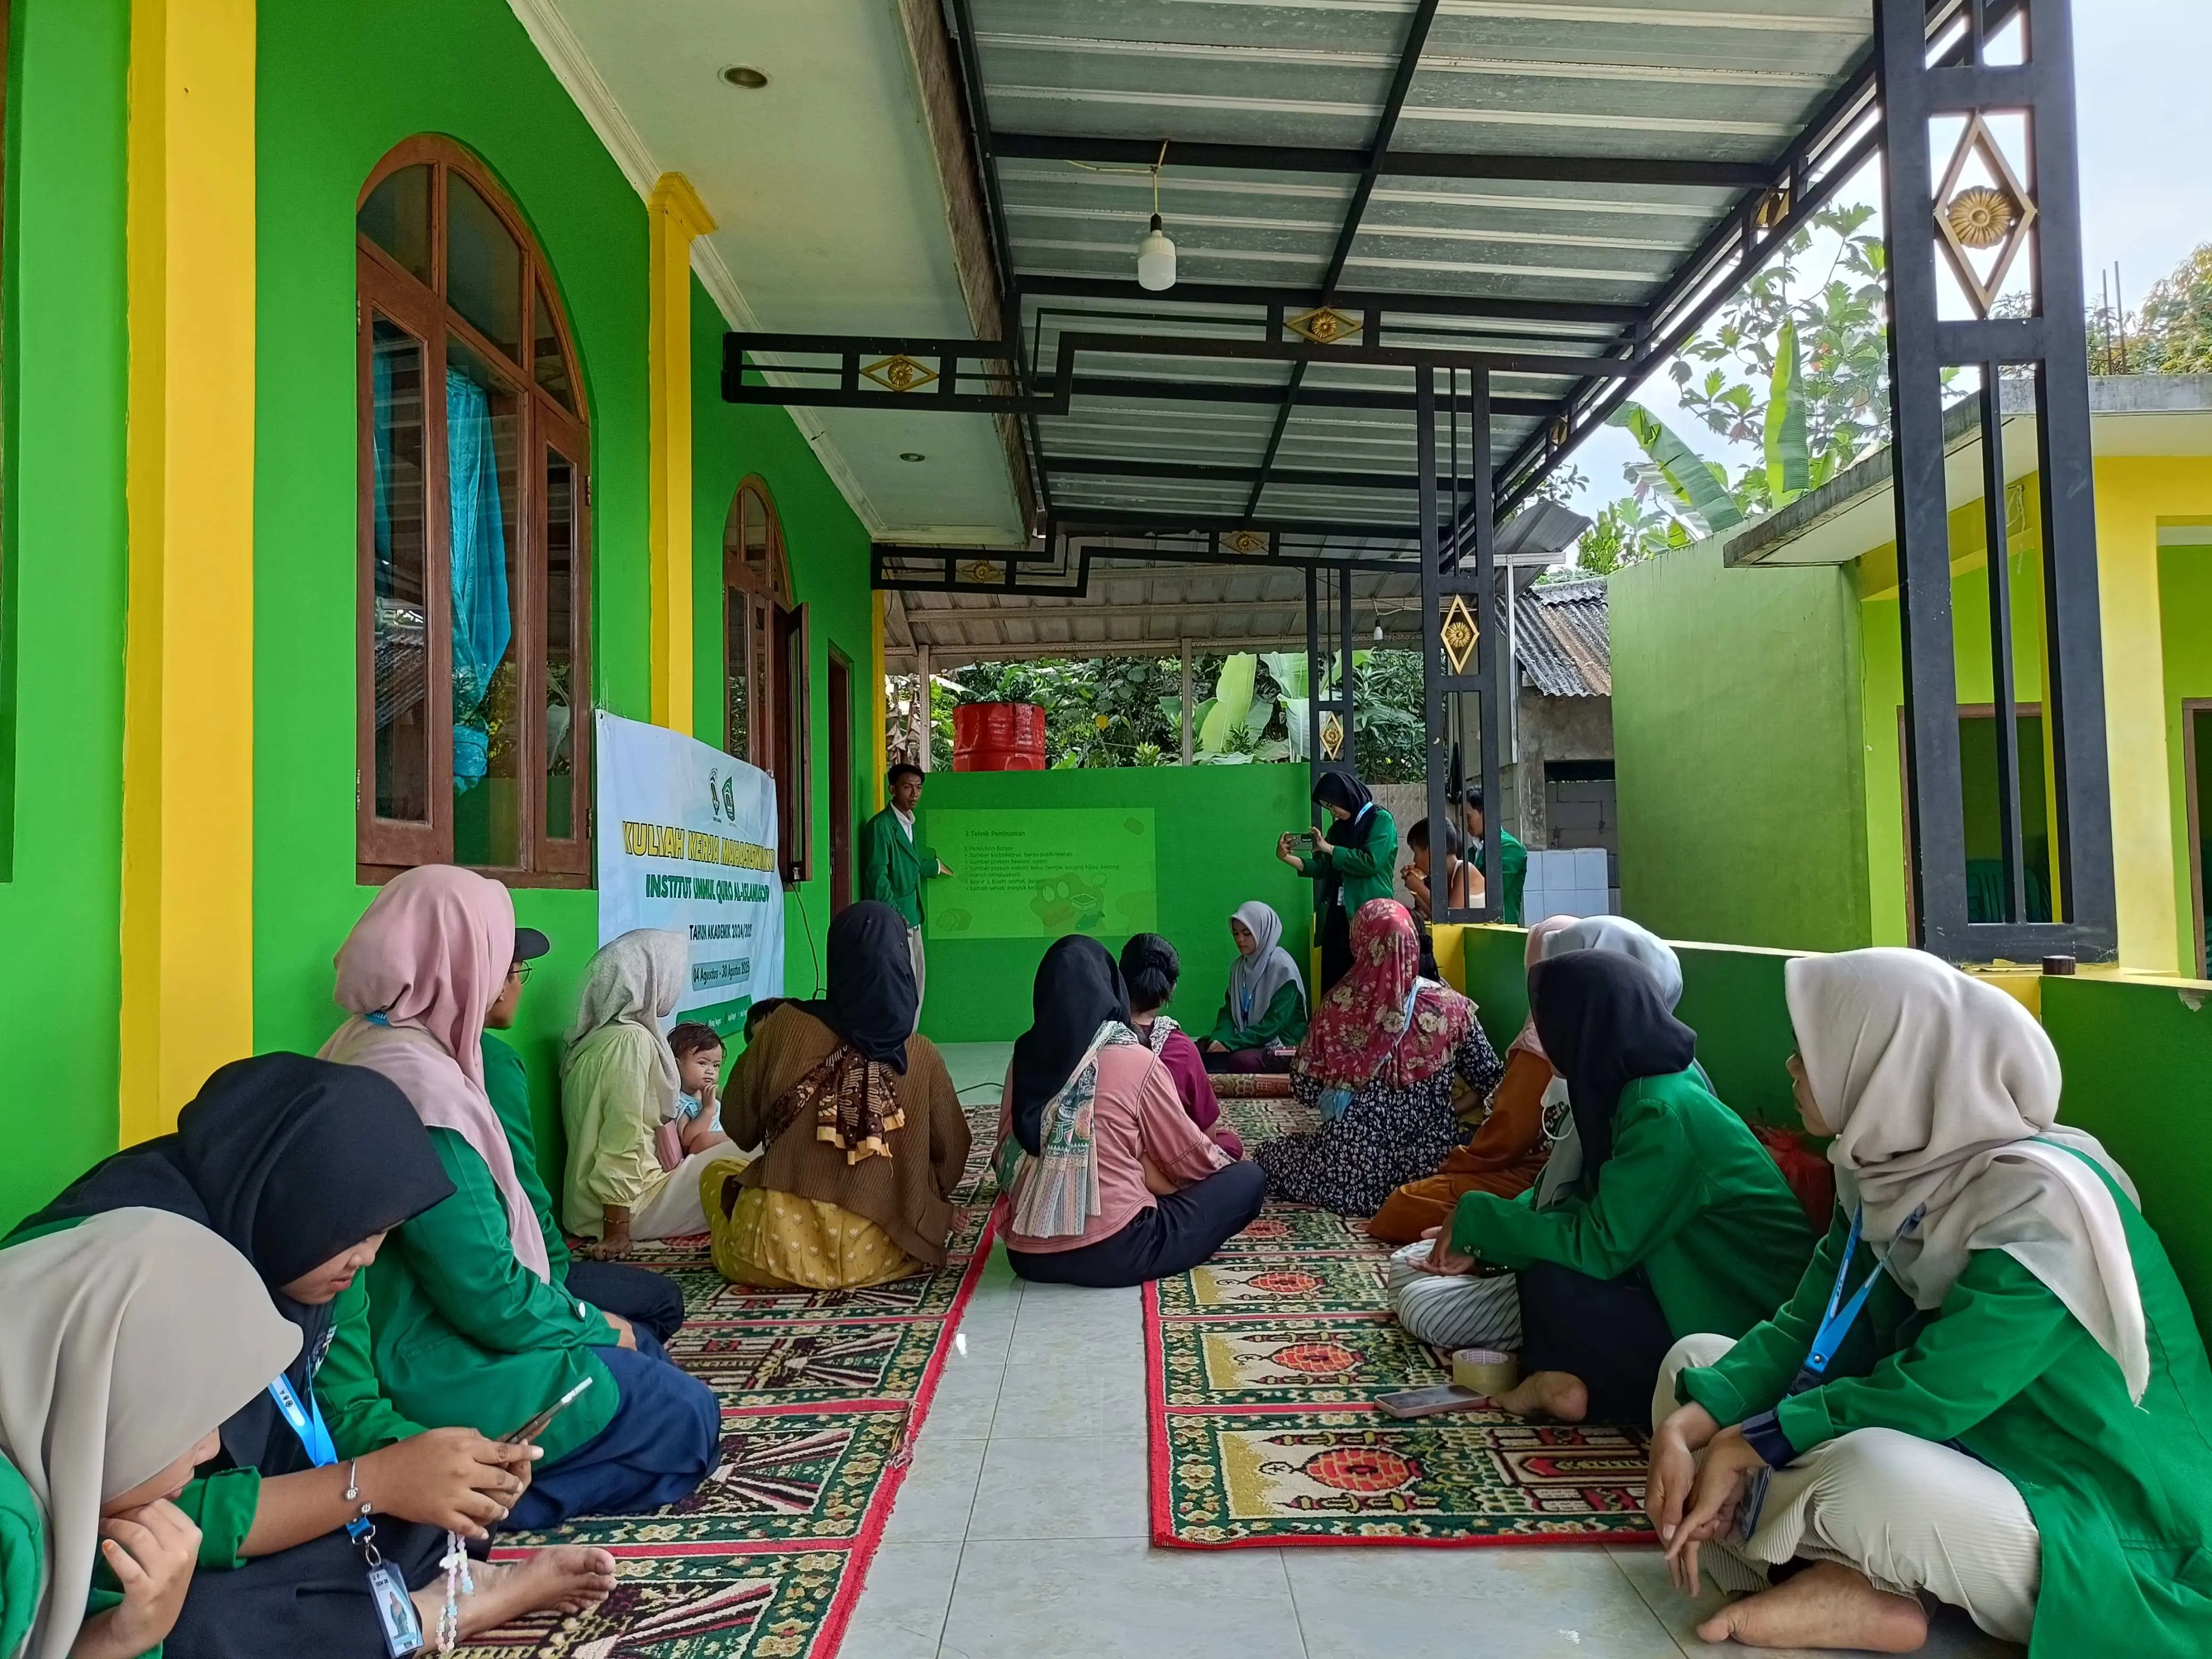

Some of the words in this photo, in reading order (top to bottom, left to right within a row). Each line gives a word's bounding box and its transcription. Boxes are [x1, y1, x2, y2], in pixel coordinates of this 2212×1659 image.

[622, 820, 684, 860] KULIAH
[688, 830, 719, 865] KERJA
[646, 874, 691, 900] INSTITUT
[693, 877, 716, 901] UMMUL
[716, 879, 733, 905] QURO
[689, 925, 707, 941] TAHUN
[708, 925, 731, 940] AKADEMIK
[693, 967, 699, 983] 04
[700, 967, 718, 985] Agustus
[722, 964, 727, 978] 30
[727, 963, 741, 981] Agustus
